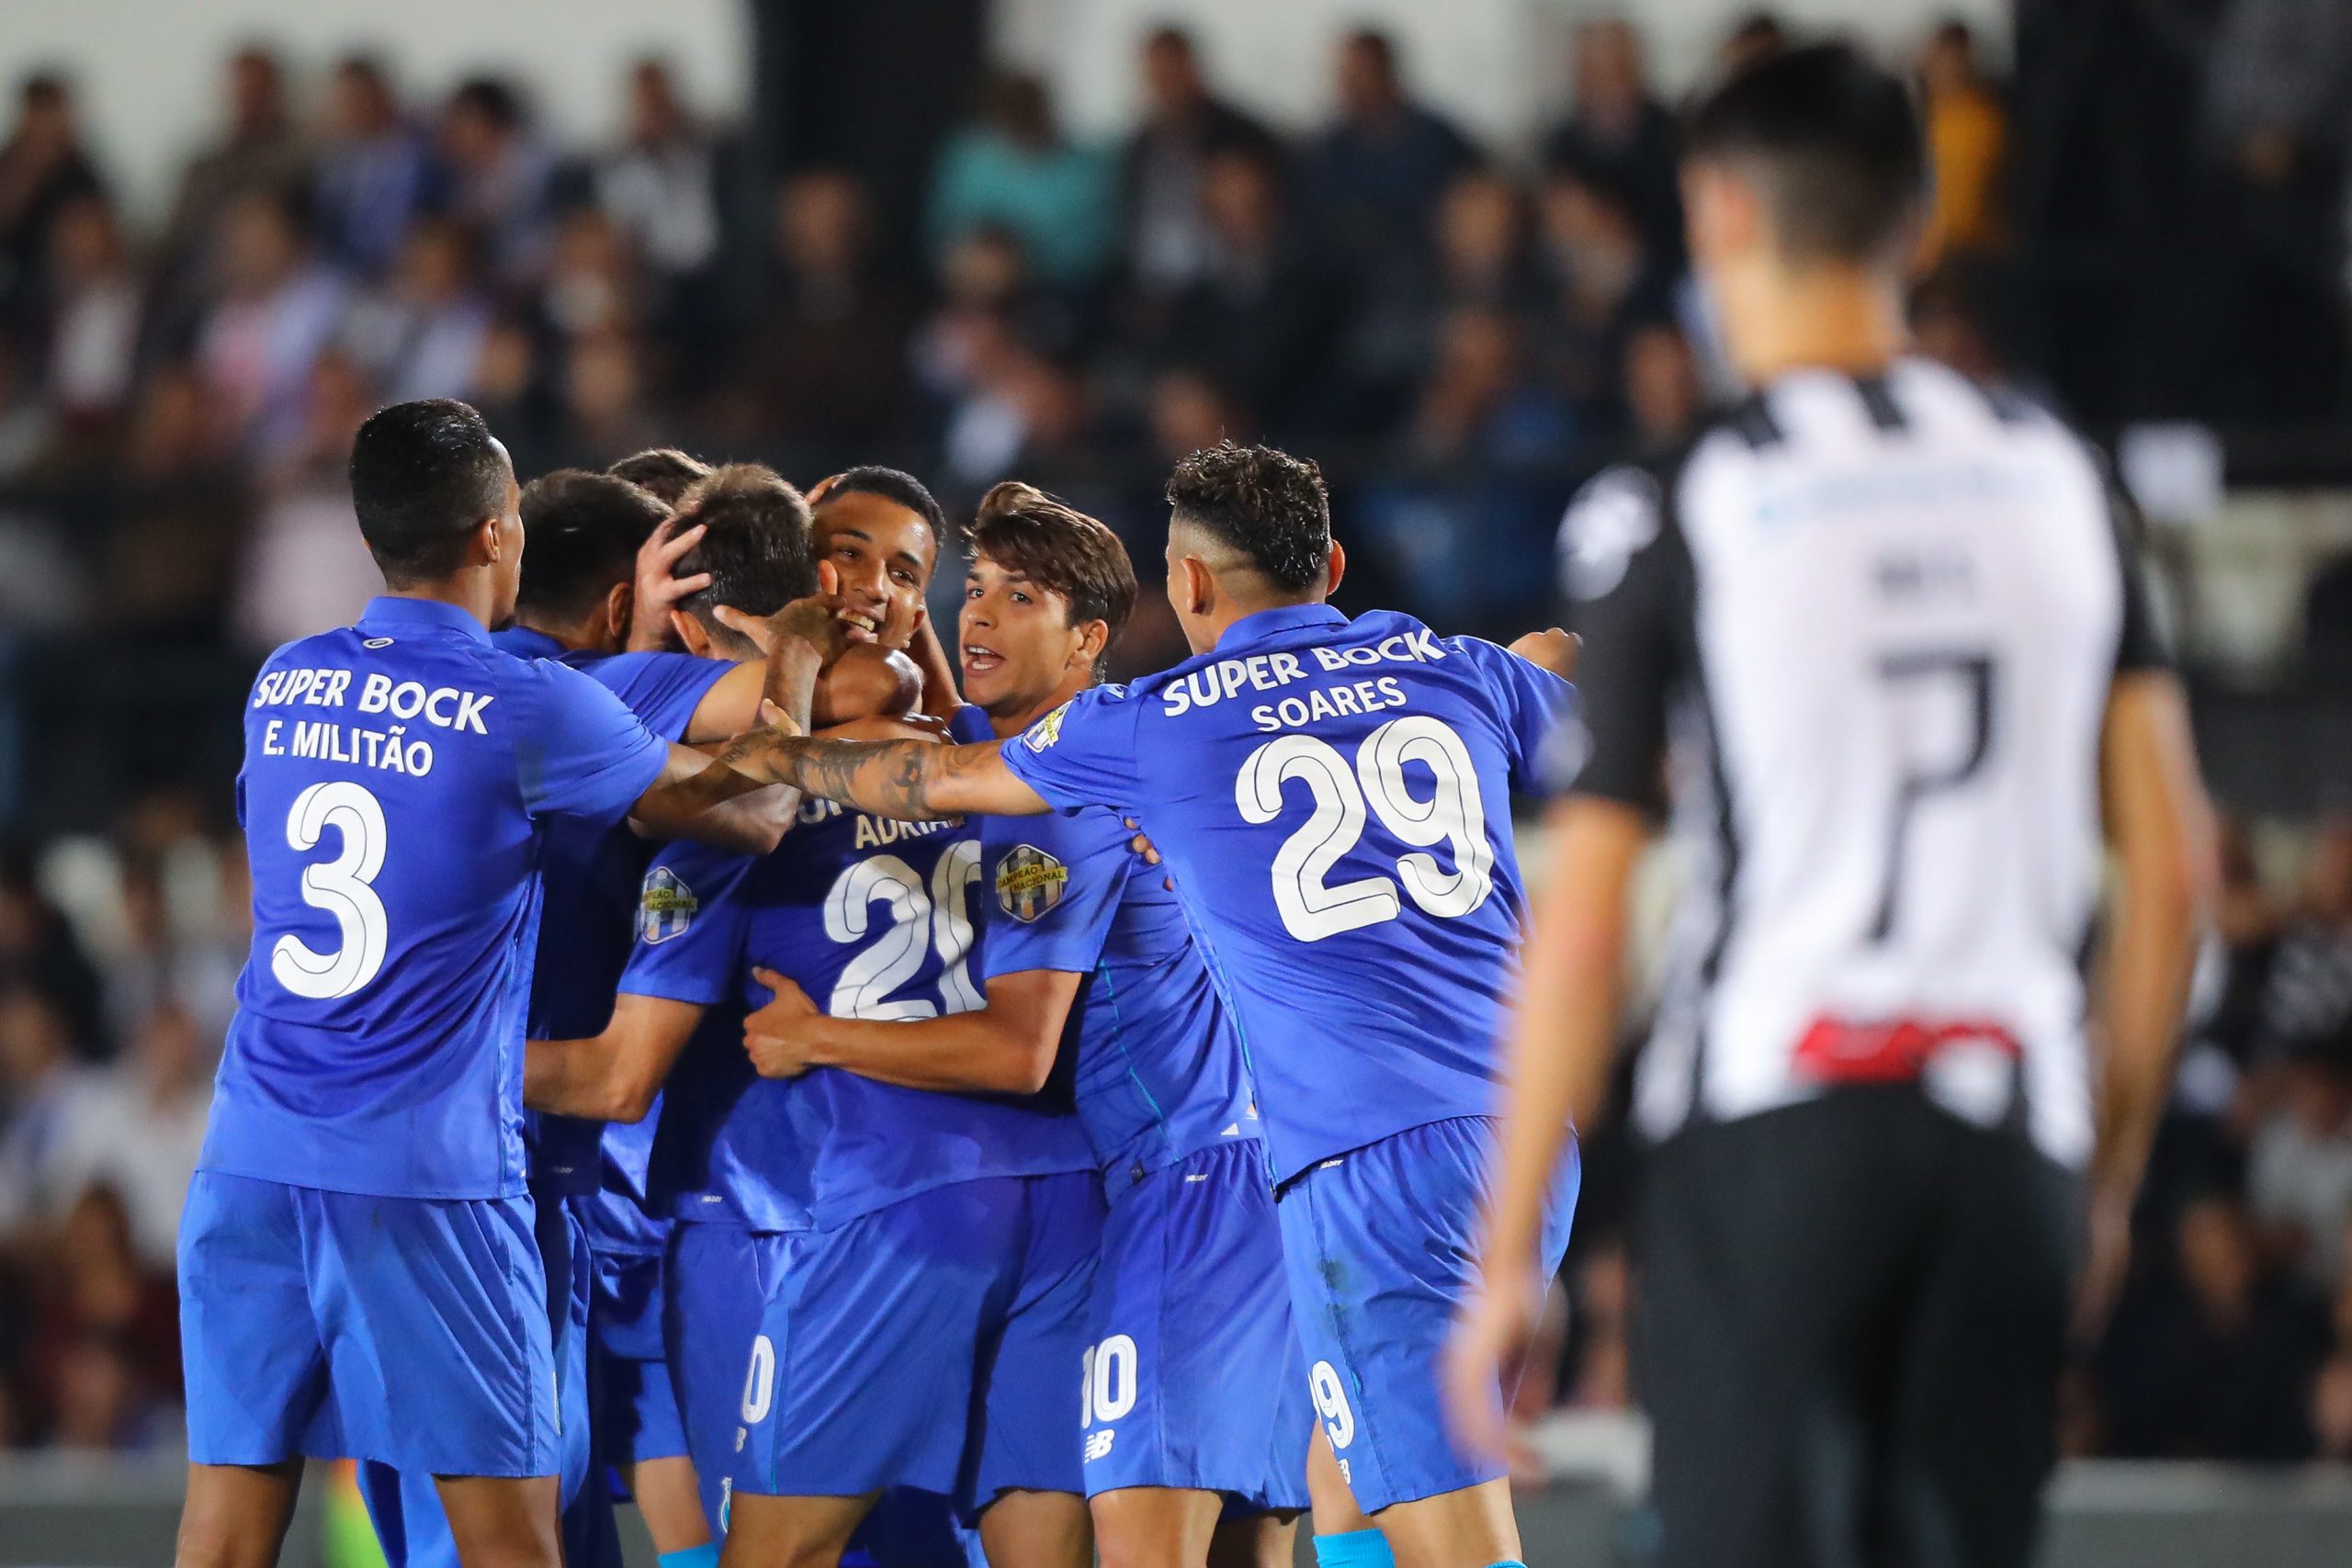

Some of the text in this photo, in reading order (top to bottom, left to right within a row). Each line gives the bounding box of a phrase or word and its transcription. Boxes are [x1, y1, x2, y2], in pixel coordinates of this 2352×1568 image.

[254, 669, 494, 735] SUPER BOCK
[1164, 628, 1447, 717] SUPER BOCK
[1251, 677, 1408, 733] SOARES
[264, 720, 434, 777] E. MILITÃO
[1235, 716, 1494, 942] 29
[271, 781, 389, 999] 3
[1082, 1335, 1137, 1428] 10
